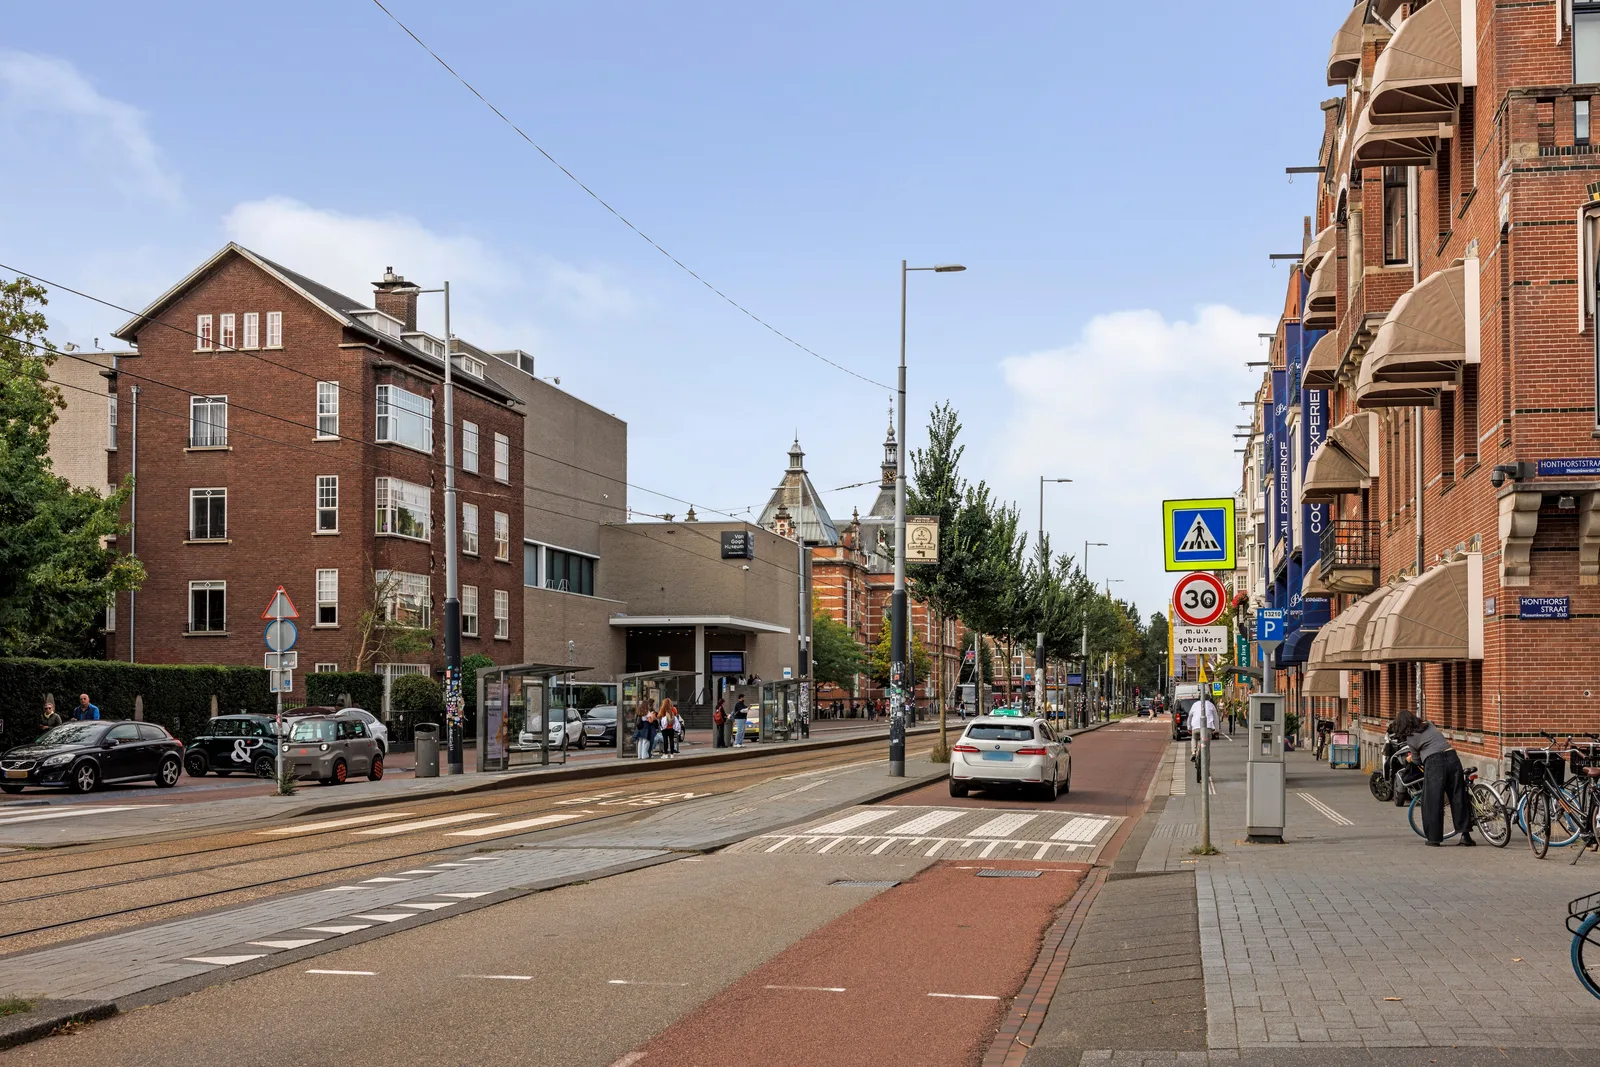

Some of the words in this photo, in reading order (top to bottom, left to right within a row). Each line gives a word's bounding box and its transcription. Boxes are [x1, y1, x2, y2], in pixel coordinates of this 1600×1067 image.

[1183, 589, 1217, 609] 30
[1264, 620, 1276, 638] P
[1178, 637, 1222, 645] gebruikers
